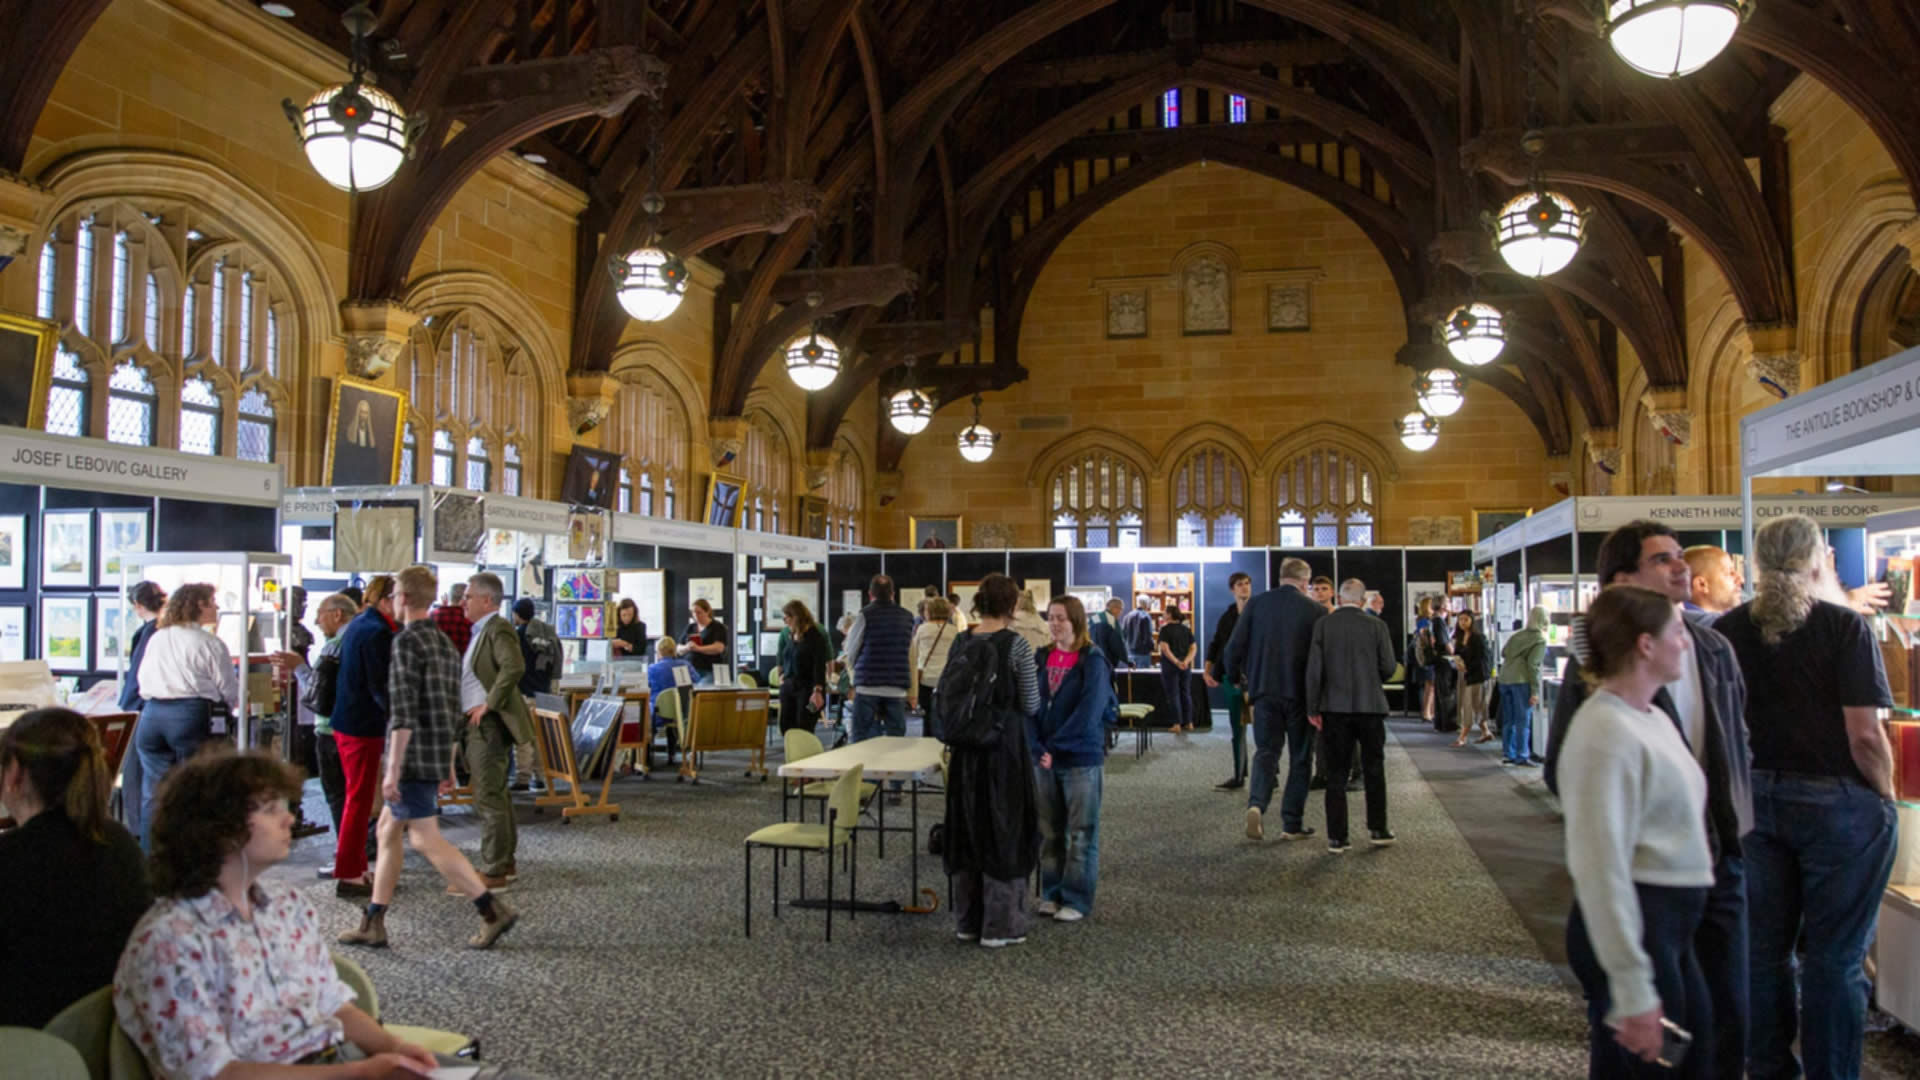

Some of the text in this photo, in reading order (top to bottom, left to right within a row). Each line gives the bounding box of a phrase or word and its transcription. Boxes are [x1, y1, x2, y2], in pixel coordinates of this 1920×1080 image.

[1785, 421, 1801, 441] THE
[1803, 407, 1842, 437] ANTIQUE
[1843, 384, 1903, 423] BOOKSHOP
[1904, 380, 1912, 401] &
[12, 448, 189, 481] JOSEF LEBOVIC GALLERY
[264, 479, 271, 490] 6
[294, 502, 333, 513] PRINTS
[1650, 506, 1710, 518] KENNETH
[1756, 505, 1783, 517] OLD
[1798, 505, 1829, 517] FINE
[1831, 504, 1879, 517] BOOKS
